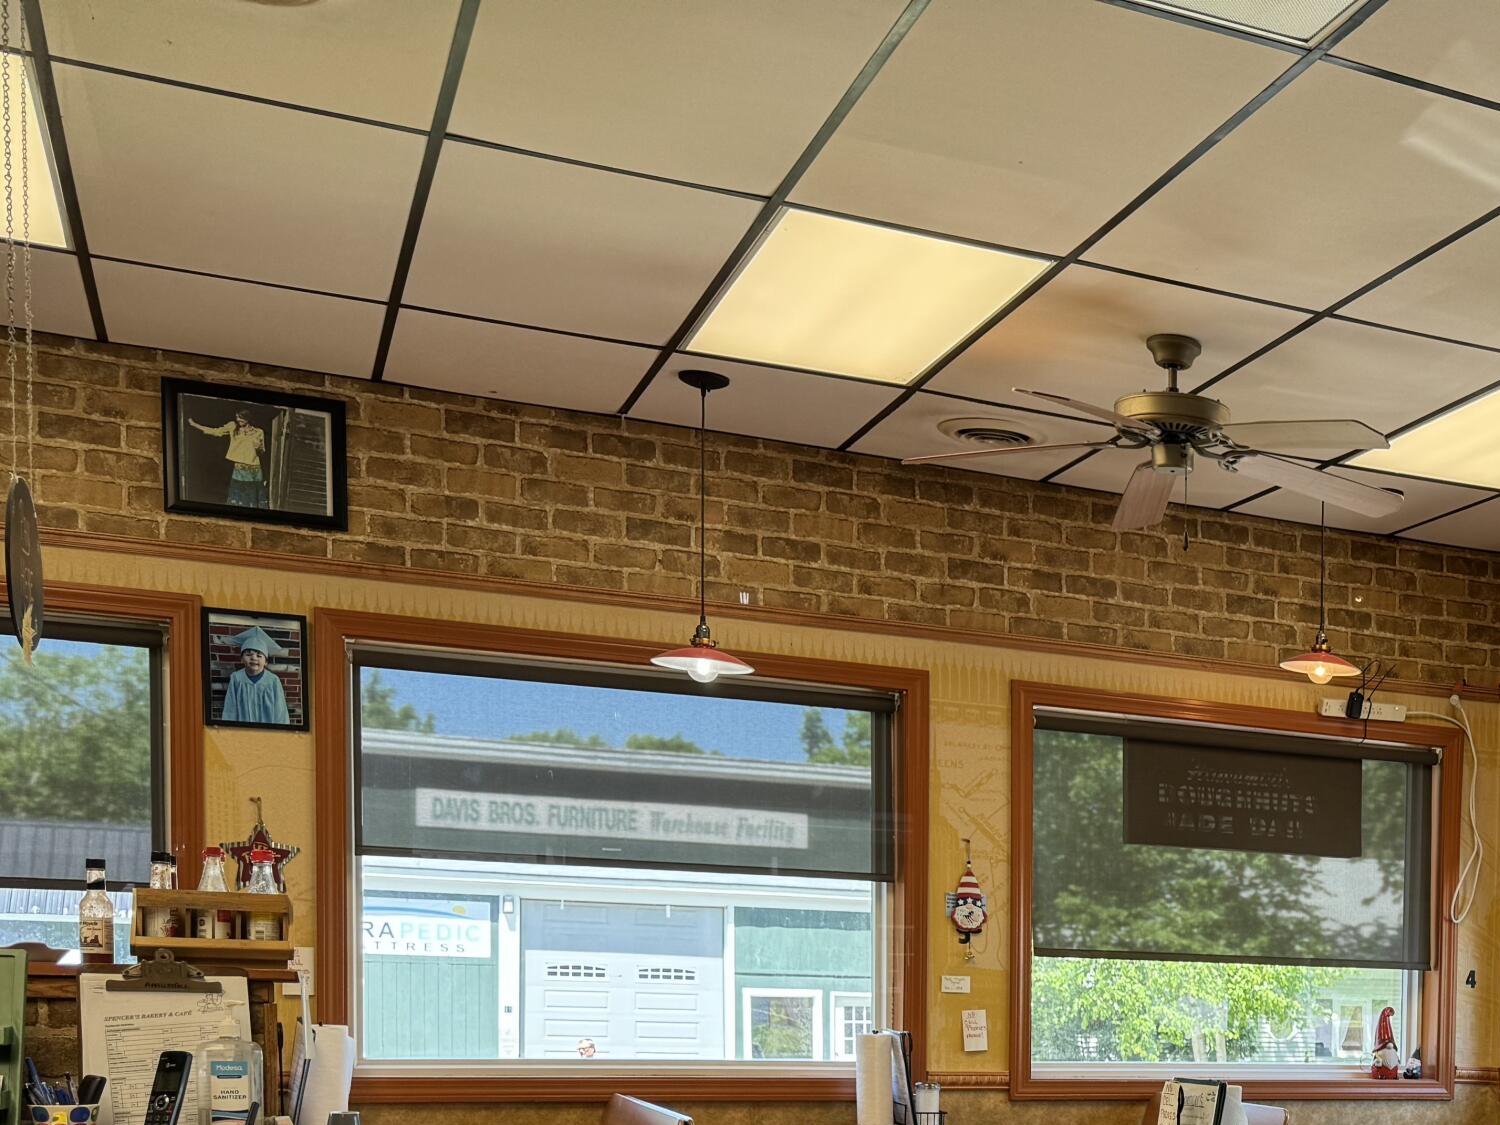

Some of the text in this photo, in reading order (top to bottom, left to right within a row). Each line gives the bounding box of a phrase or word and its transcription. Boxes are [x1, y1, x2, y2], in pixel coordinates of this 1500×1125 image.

[431, 797, 796, 843] DAVIS BROS. FURNITURE Warehouse Facility
[363, 941, 466, 953] TTRESS
[1465, 970, 1476, 989] 4
[104, 1013, 140, 1022] SPENCER'S
